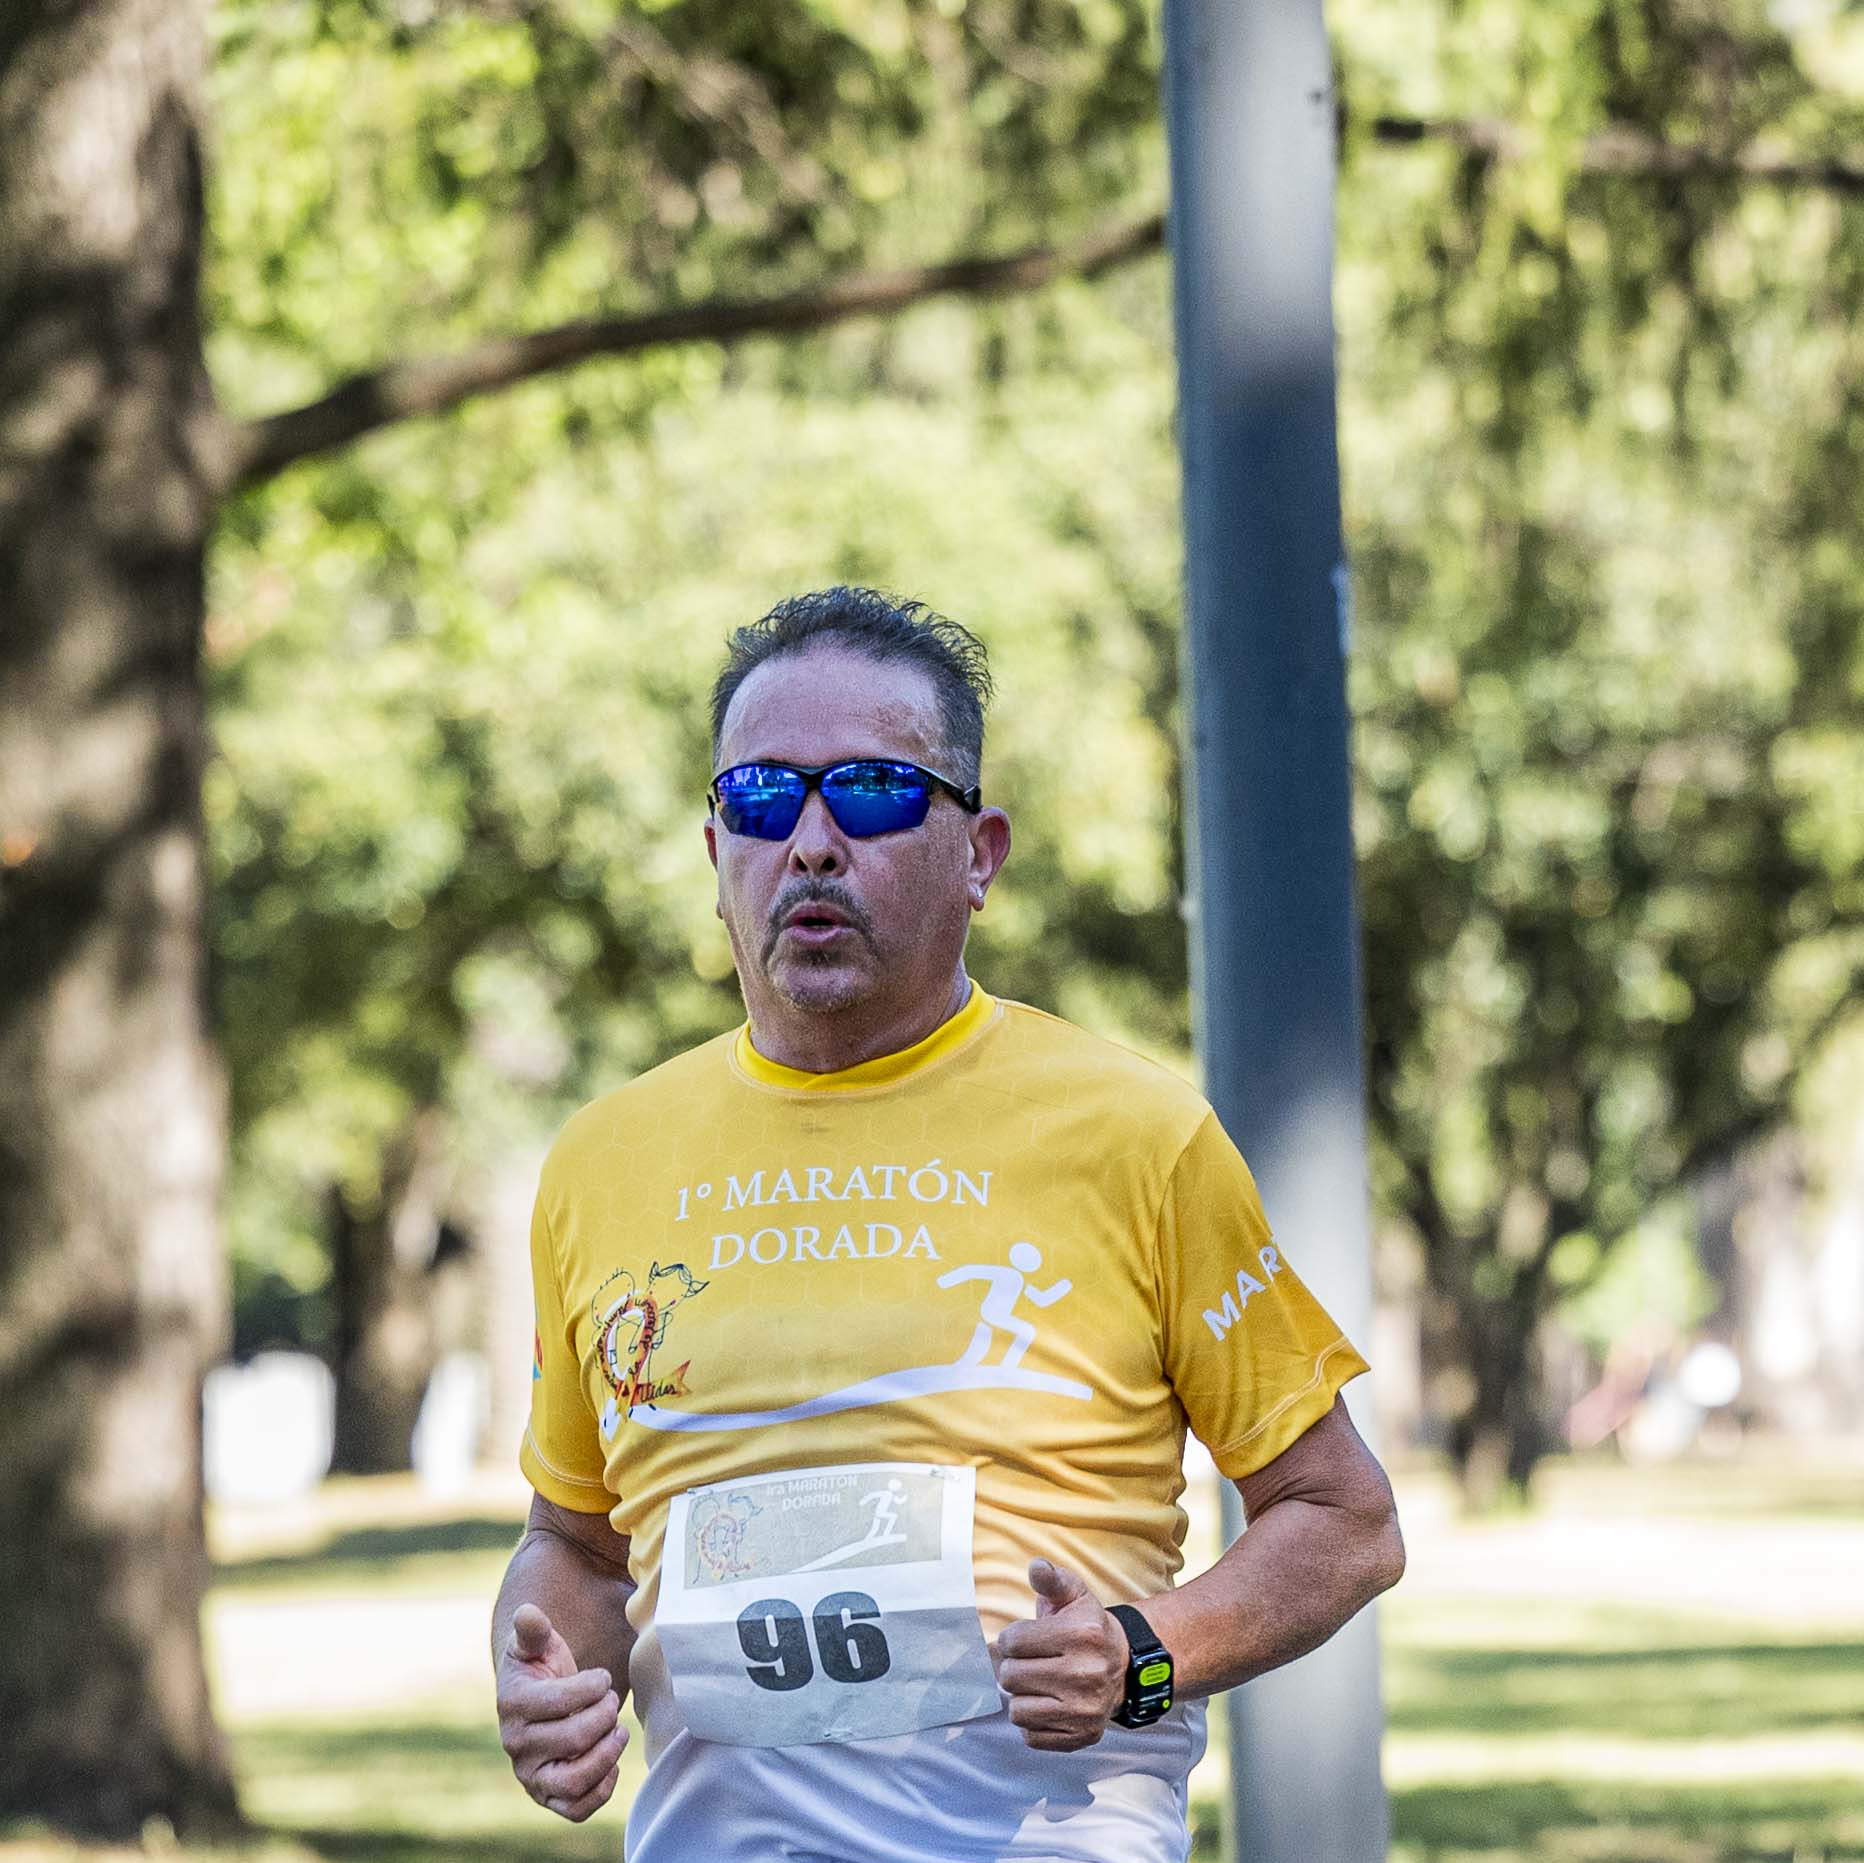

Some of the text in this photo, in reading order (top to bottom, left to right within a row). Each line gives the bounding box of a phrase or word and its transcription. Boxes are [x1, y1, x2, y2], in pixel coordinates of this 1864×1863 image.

[721, 1158, 993, 1212] MARATÓN
[707, 1222, 942, 1271] DORADA
[1202, 1231, 1281, 1341] MAR
[735, 1590, 892, 1692] 96
